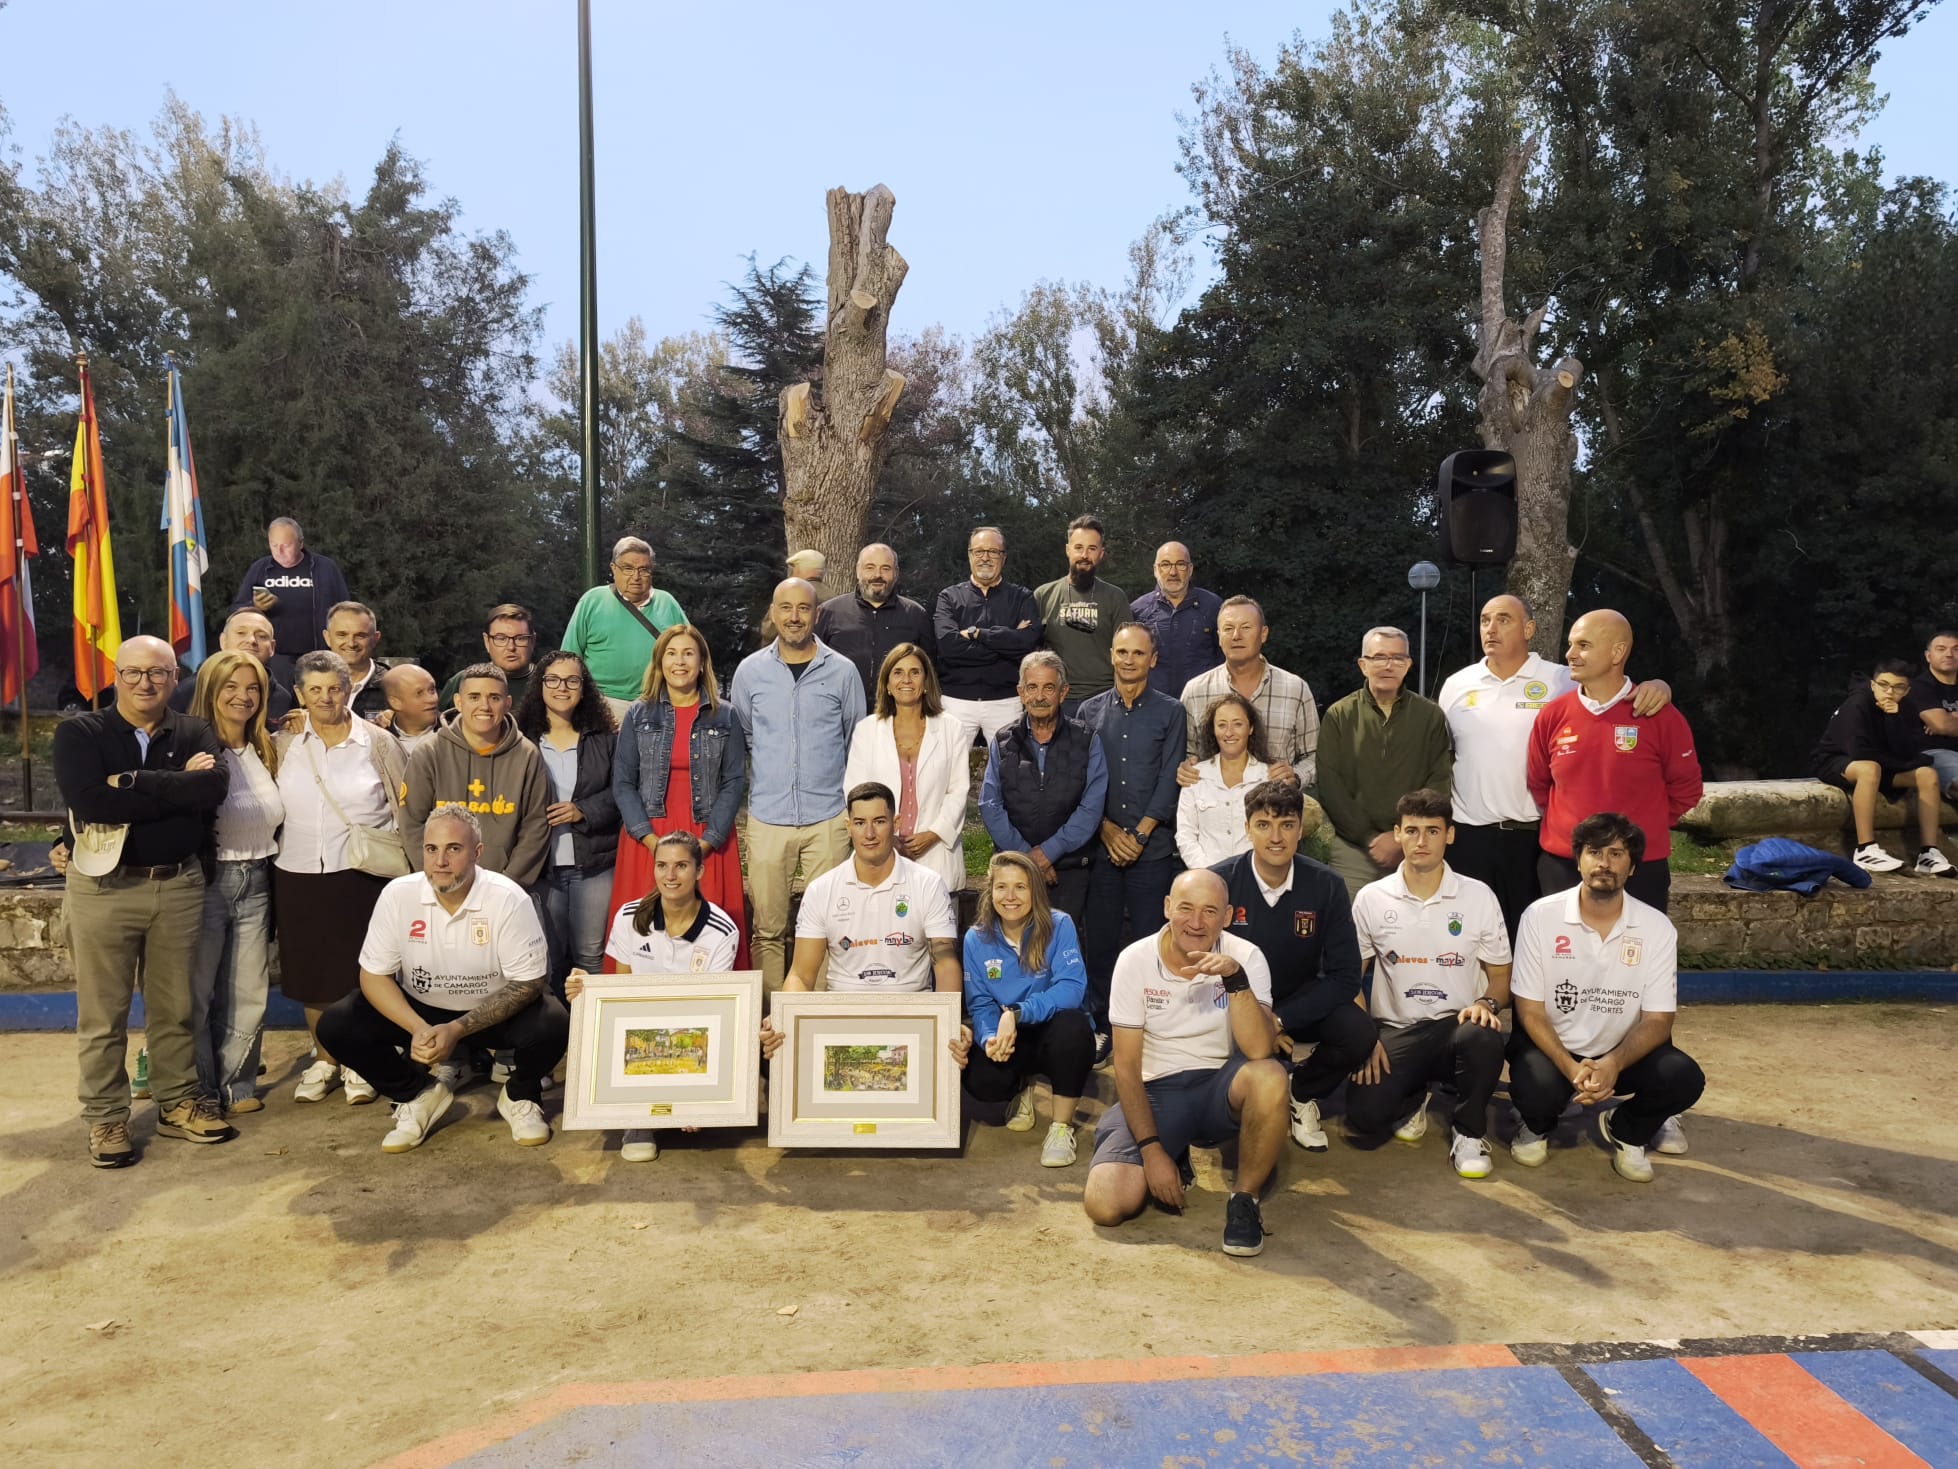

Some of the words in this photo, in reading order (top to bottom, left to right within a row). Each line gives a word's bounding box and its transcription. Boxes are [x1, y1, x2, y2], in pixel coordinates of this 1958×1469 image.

[1060, 607, 1098, 618] SATURN
[409, 920, 427, 938] 2
[1555, 935, 1572, 954] 2
[434, 971, 499, 982] AYUNTAMIENTO
[444, 981, 488, 989] CAMARGO
[448, 988, 489, 996] DEPORTES
[1589, 996, 1625, 1006] CMARGO
